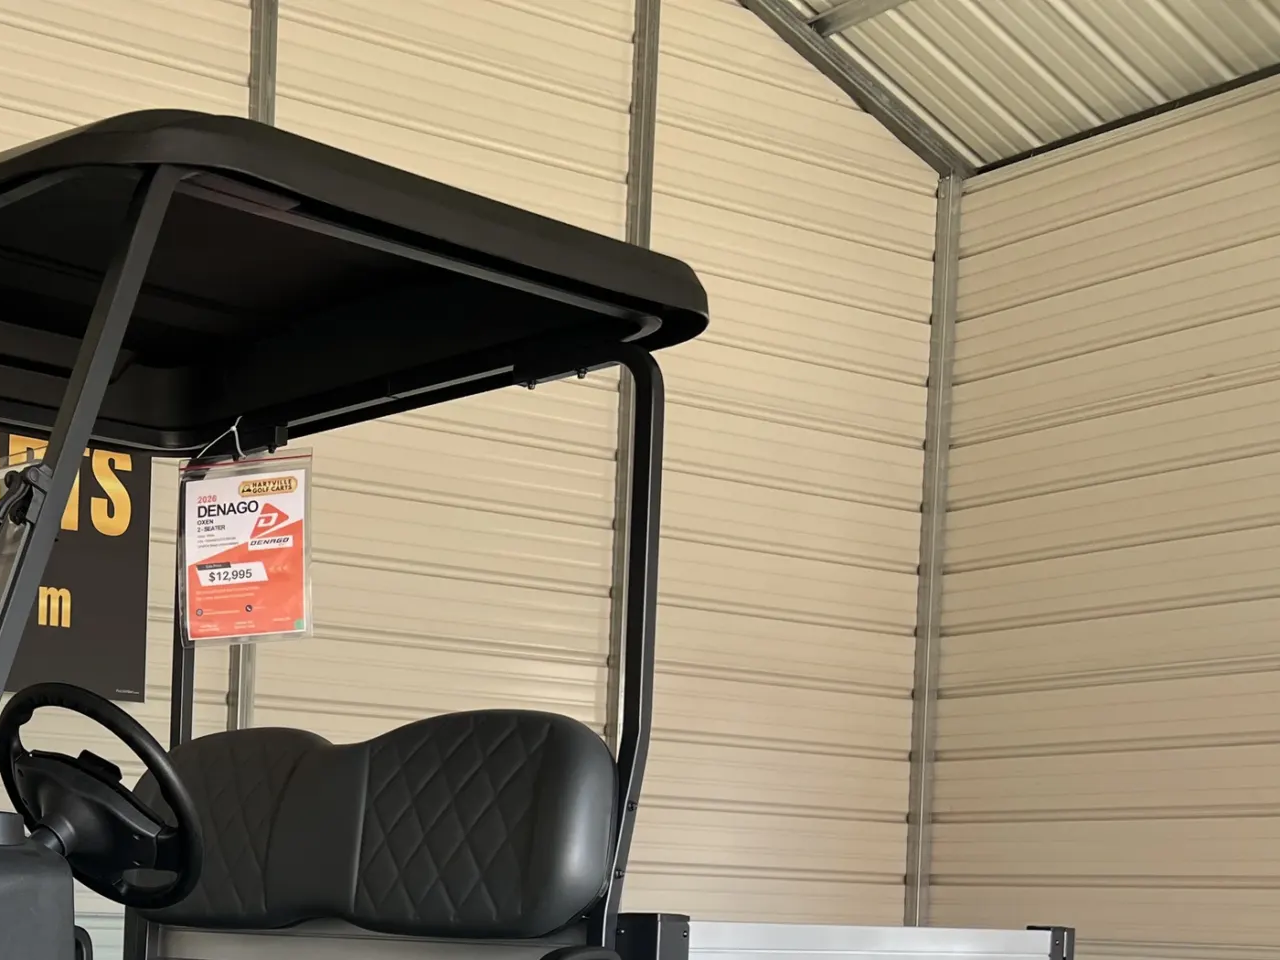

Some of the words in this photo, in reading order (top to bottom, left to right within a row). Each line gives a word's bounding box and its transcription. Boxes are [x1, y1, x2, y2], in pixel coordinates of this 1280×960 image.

[252, 479, 292, 488] HARTVILLE
[252, 486, 269, 494] GOLF
[271, 484, 293, 492] CARTS
[197, 495, 218, 504] 2026
[197, 500, 259, 519] DENAGO
[250, 537, 290, 546] DENAGO
[208, 569, 253, 583] $12,995
